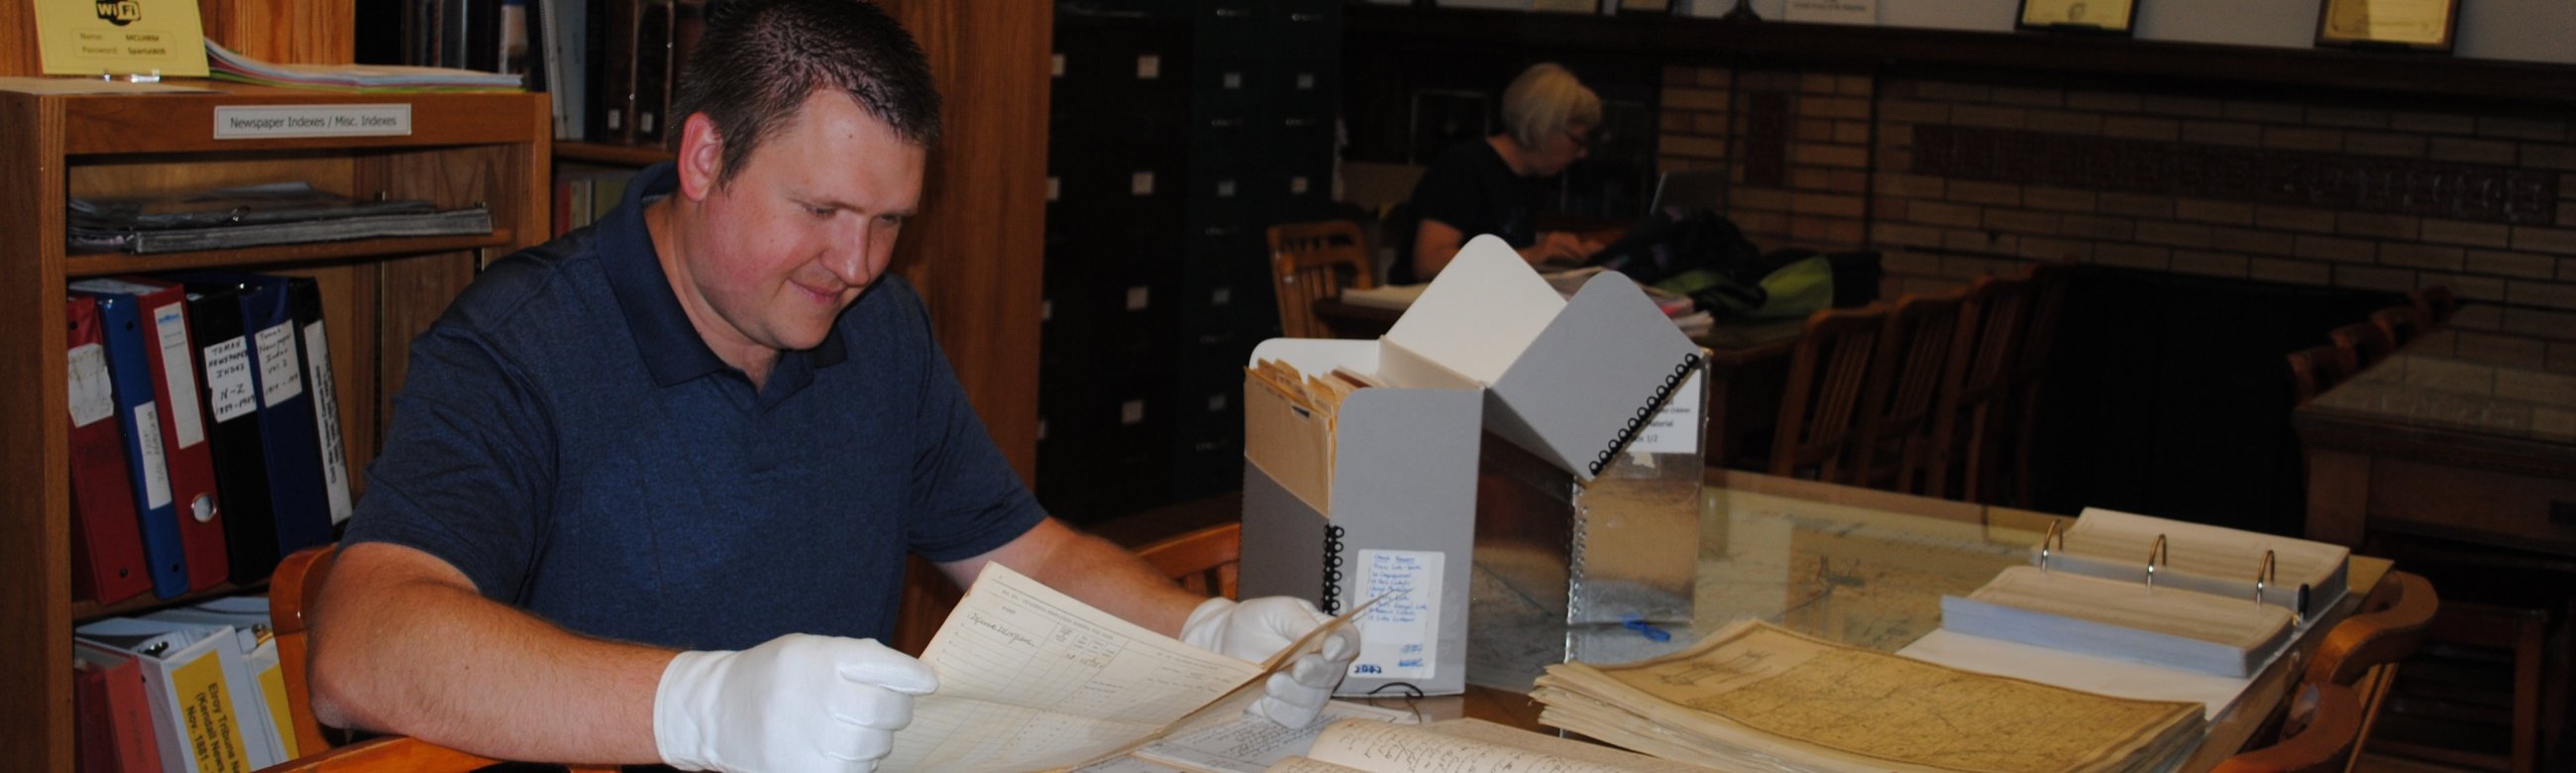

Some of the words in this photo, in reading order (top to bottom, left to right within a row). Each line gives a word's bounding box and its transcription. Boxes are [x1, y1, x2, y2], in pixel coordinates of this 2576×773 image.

[230, 117, 284, 129] Newspaper
[287, 116, 325, 128] Indexes
[335, 115, 358, 127] Misc.
[362, 115, 397, 126] Indexes
[186, 705, 198, 734] Nov.
[196, 692, 217, 741] (Kendall
[208, 682, 223, 715] Elroy
[218, 714, 236, 759] Tribune
